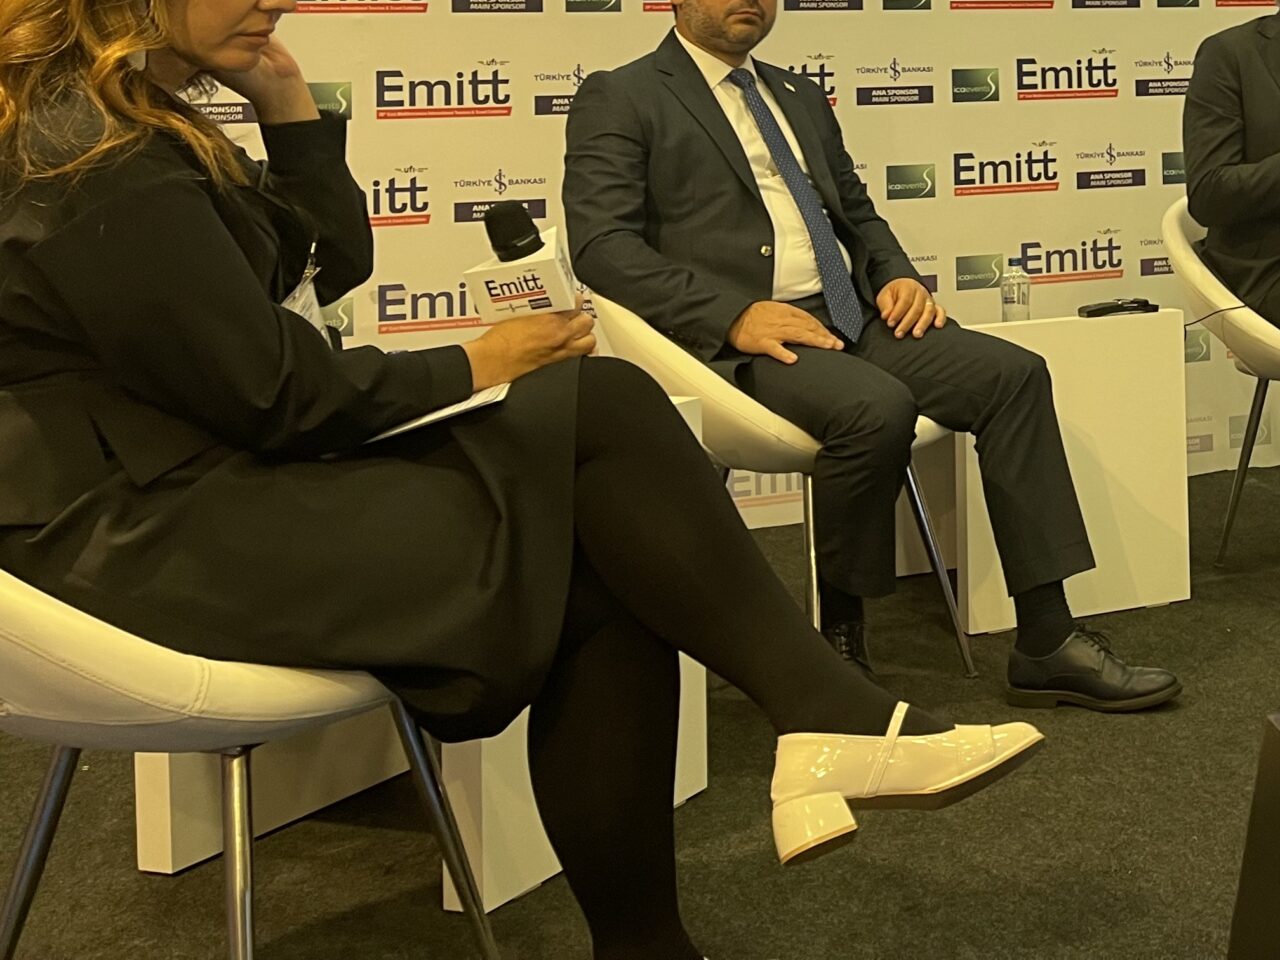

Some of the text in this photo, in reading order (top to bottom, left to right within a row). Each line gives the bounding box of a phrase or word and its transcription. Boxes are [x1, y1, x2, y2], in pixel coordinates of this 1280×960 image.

[375, 68, 511, 108] Emitt
[1017, 57, 1117, 91] Emitt
[953, 149, 1058, 186] Emitt
[1020, 236, 1123, 275] Emitt
[484, 273, 544, 298] Emitt
